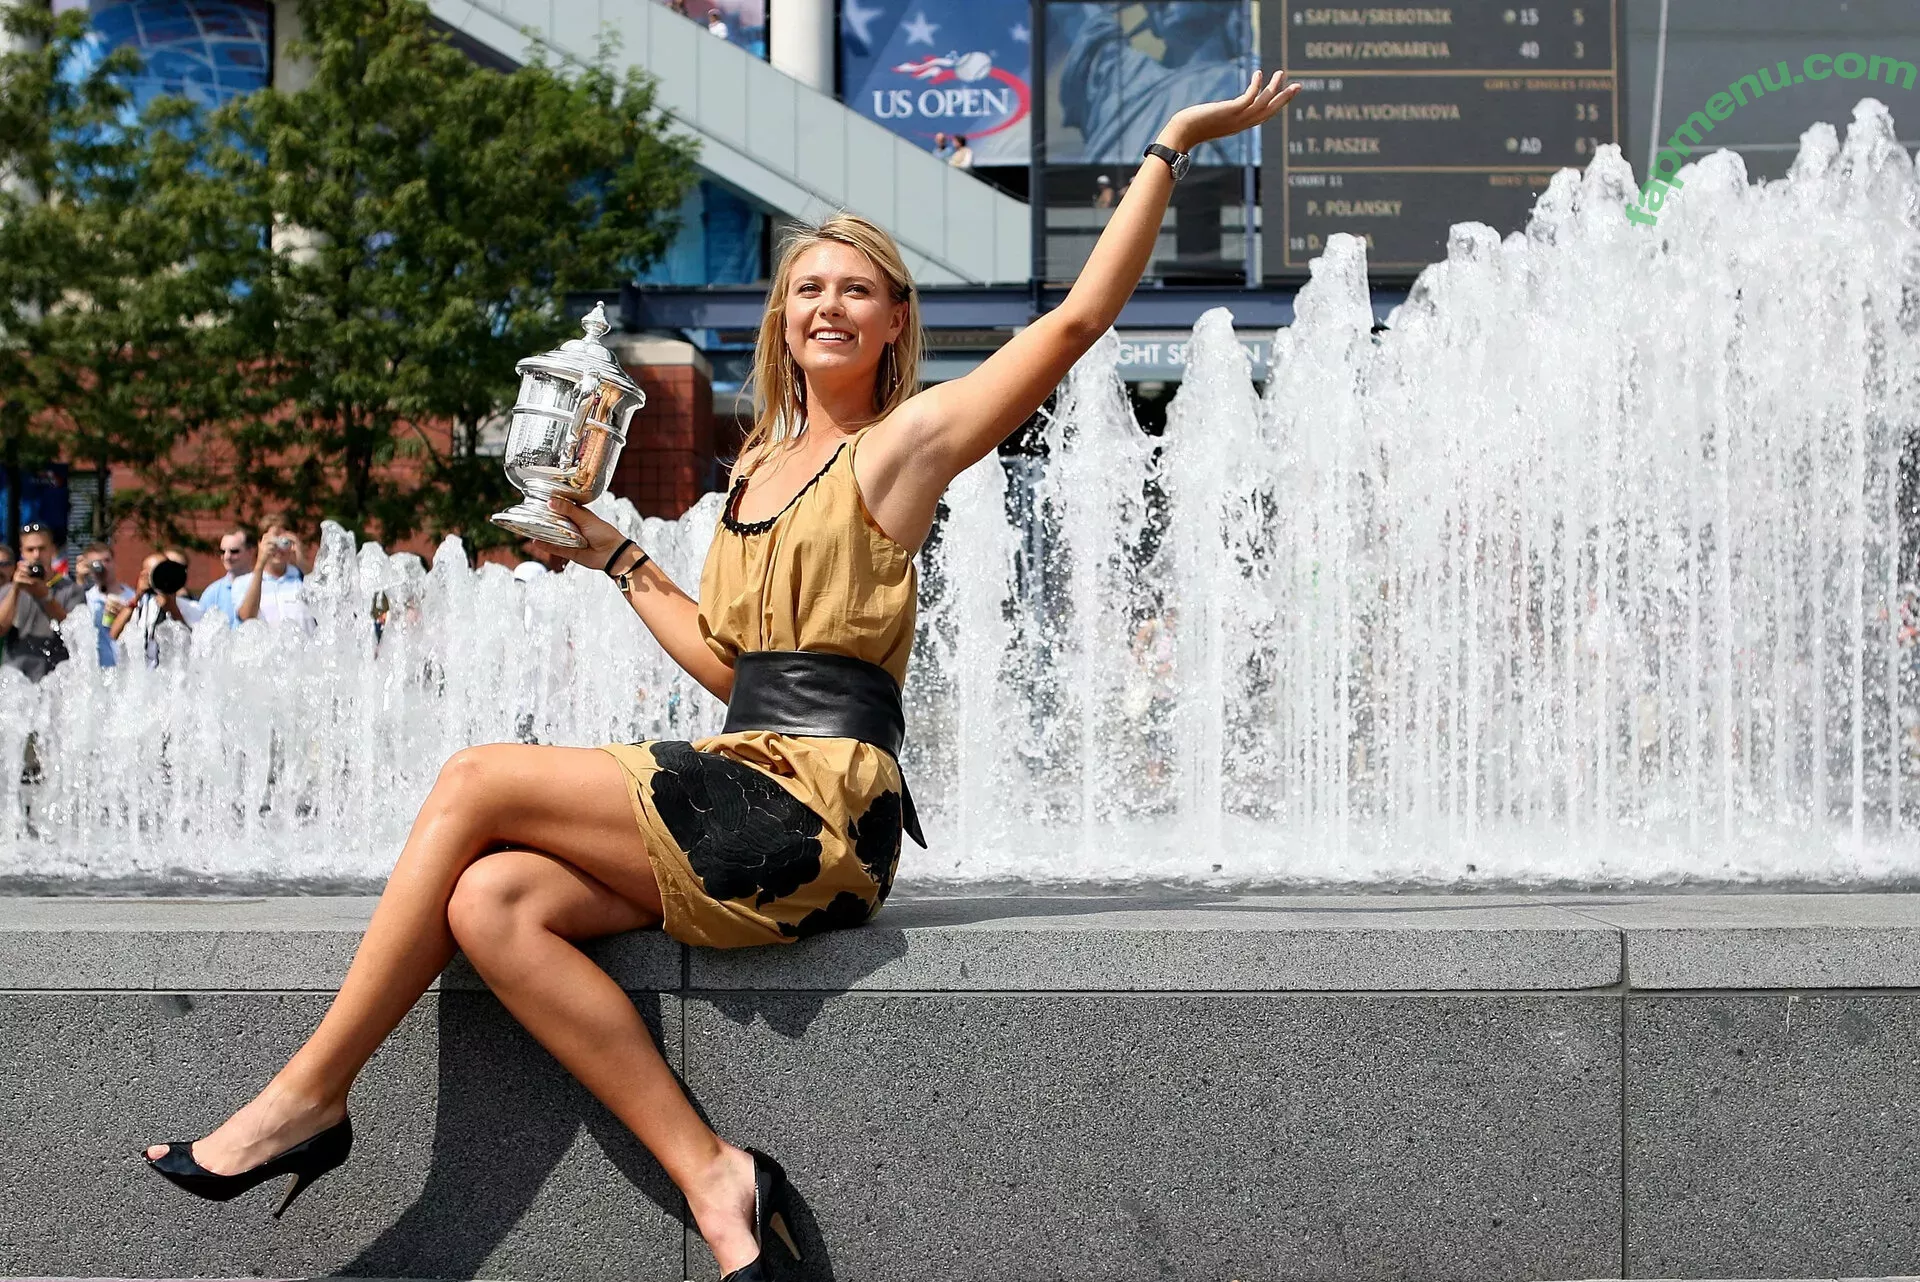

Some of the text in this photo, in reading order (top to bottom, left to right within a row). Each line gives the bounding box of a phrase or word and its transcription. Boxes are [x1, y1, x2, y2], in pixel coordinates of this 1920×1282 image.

[1305, 8, 1453, 25] SAFINA/SREBOTNIK
[1520, 8, 1539, 25] 15
[1573, 8, 1584, 25] 5
[1305, 41, 1450, 59] DECHY/ZVONAREVA
[1519, 41, 1539, 58] 40
[872, 88, 1009, 119] US OPEN
[1305, 104, 1322, 121] A.
[1324, 103, 1461, 121] PAVLYUCHENKOVA
[1305, 137, 1321, 154] T.
[1324, 137, 1381, 154] PASZEK
[1520, 136, 1542, 154] AD
[1306, 200, 1402, 217] P. POLANSKY
